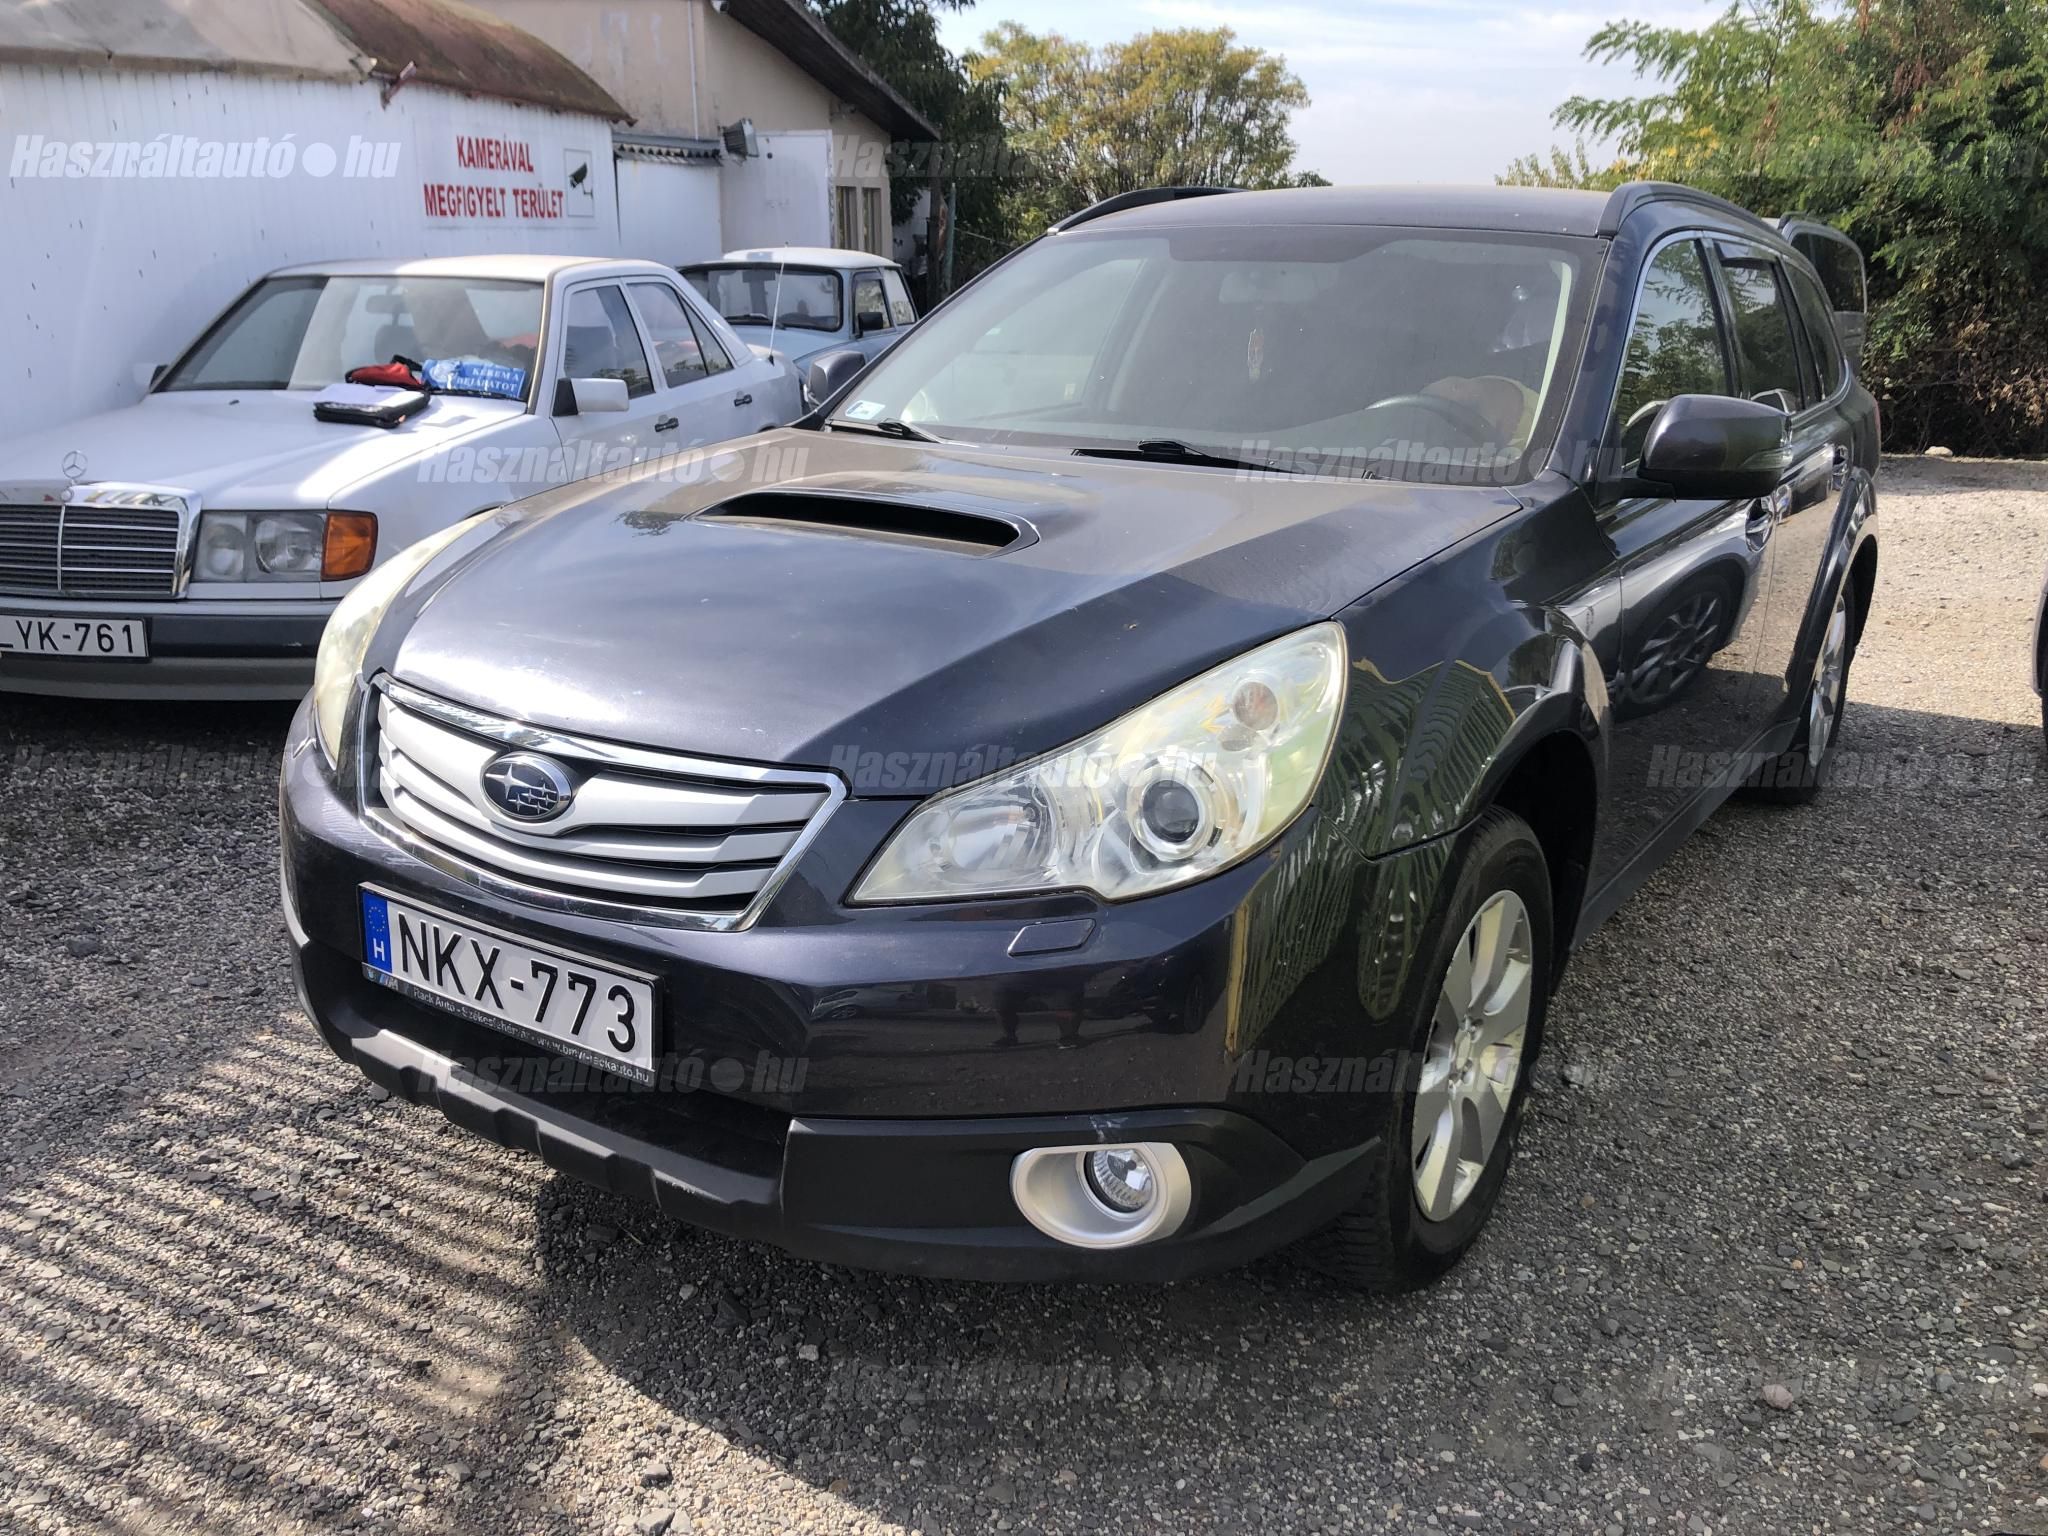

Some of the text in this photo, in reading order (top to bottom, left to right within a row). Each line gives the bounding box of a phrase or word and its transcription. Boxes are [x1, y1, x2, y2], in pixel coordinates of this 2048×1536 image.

[457, 133, 534, 173] KAMERÁVAL
[424, 183, 564, 219] MEGFIGYELT TERÜLET
[373, 939, 386, 962] H
[398, 912, 637, 1053] NKX-773
